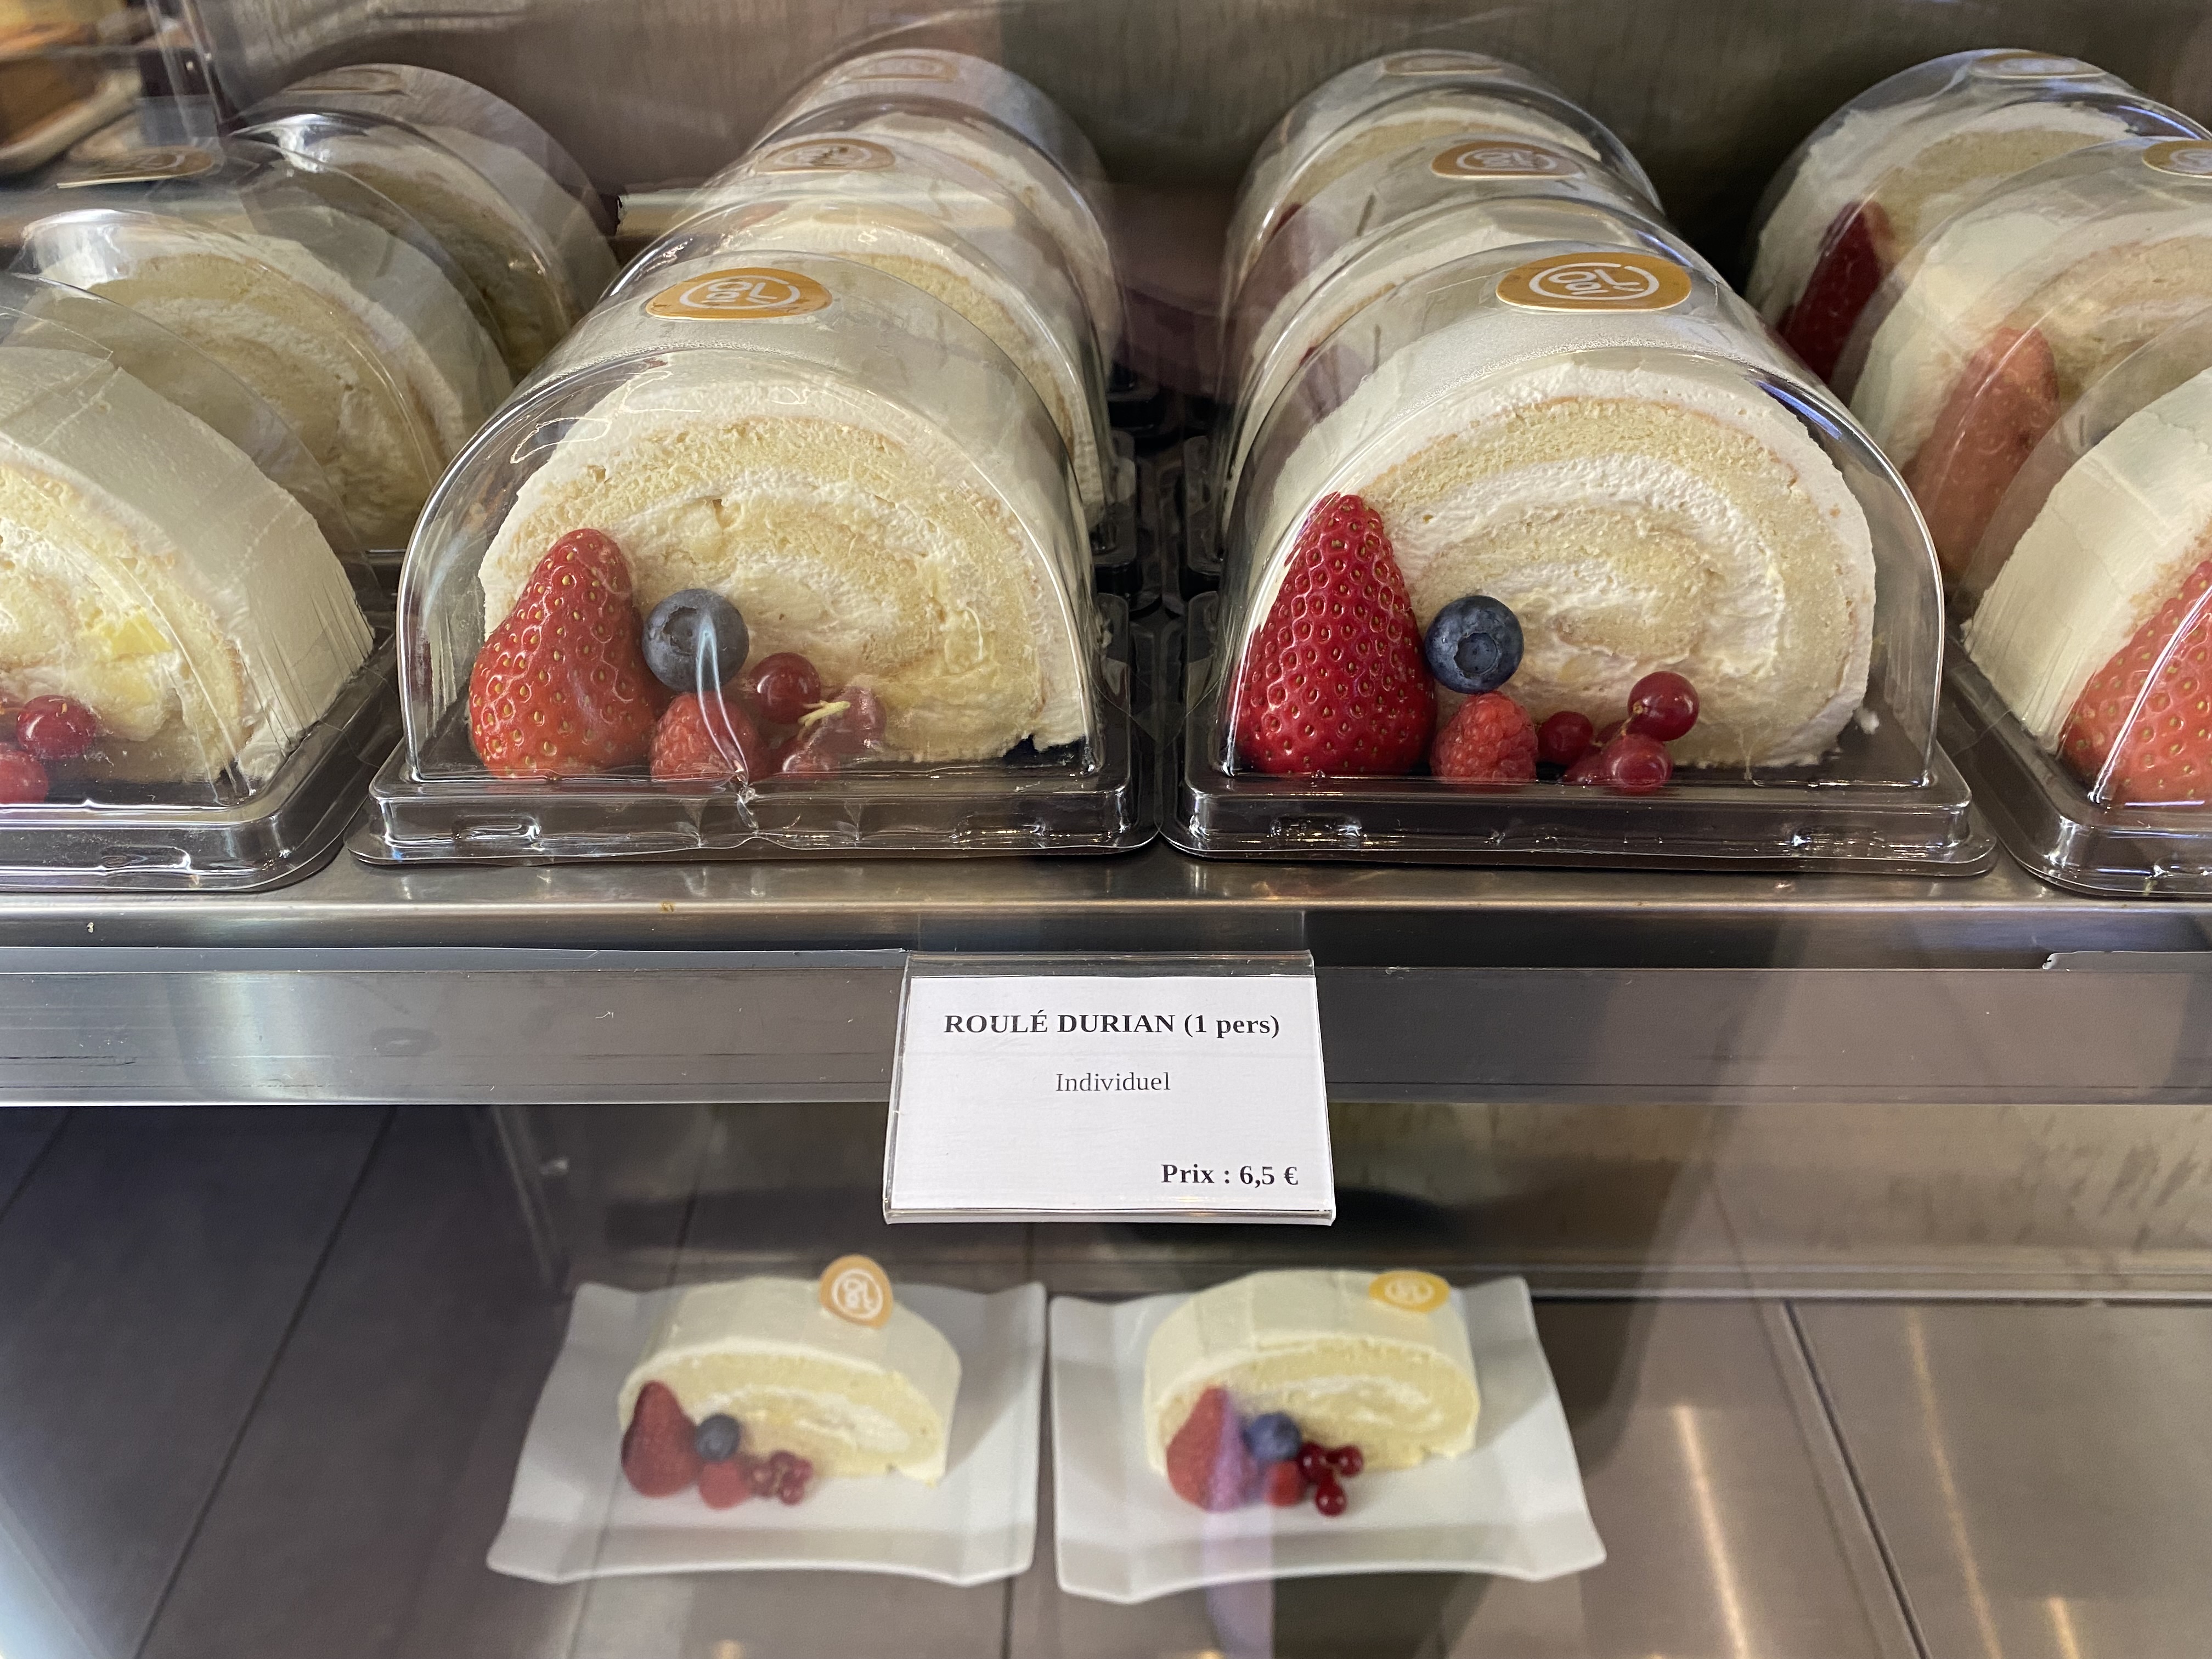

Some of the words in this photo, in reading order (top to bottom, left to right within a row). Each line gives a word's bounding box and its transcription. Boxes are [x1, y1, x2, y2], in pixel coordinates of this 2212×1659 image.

[944, 1009, 1048, 1034] ROULÉ
[1057, 1014, 1176, 1033] DURIAN
[1184, 1013, 1207, 1038] (1
[1216, 1014, 1280, 1039] pers)
[1056, 1072, 1171, 1092] Individuel
[1161, 1163, 1215, 1184] Prix
[1239, 1165, 1276, 1189] 6,5
[1283, 1166, 1299, 1186] €
